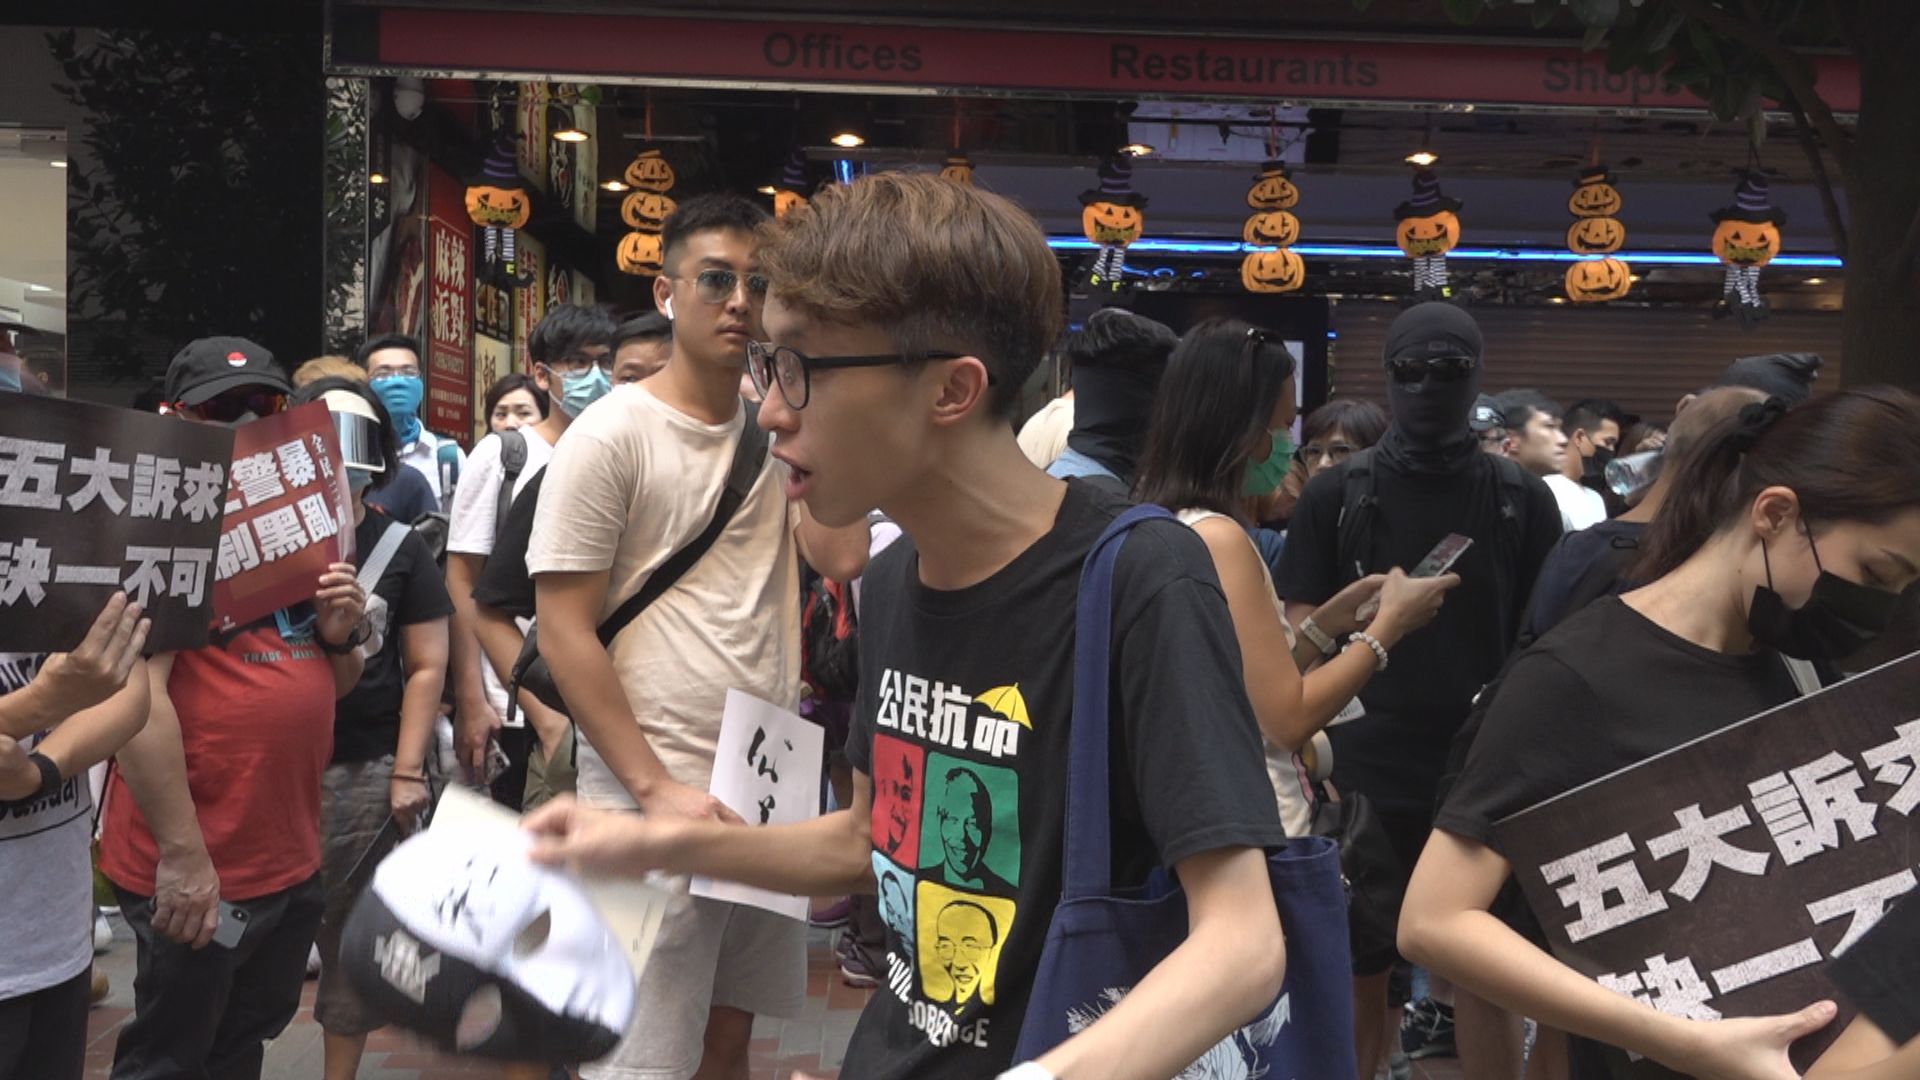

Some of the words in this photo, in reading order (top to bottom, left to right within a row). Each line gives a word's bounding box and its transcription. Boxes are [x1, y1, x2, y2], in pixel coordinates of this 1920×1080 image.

[763, 32, 924, 72] Offices
[1109, 44, 1378, 87] Restaurants
[0, 436, 224, 523] 五大訴求
[224, 438, 316, 515] 警暴
[0, 538, 212, 608] 缺一不可
[1597, 863, 1920, 1022] 缺一不
